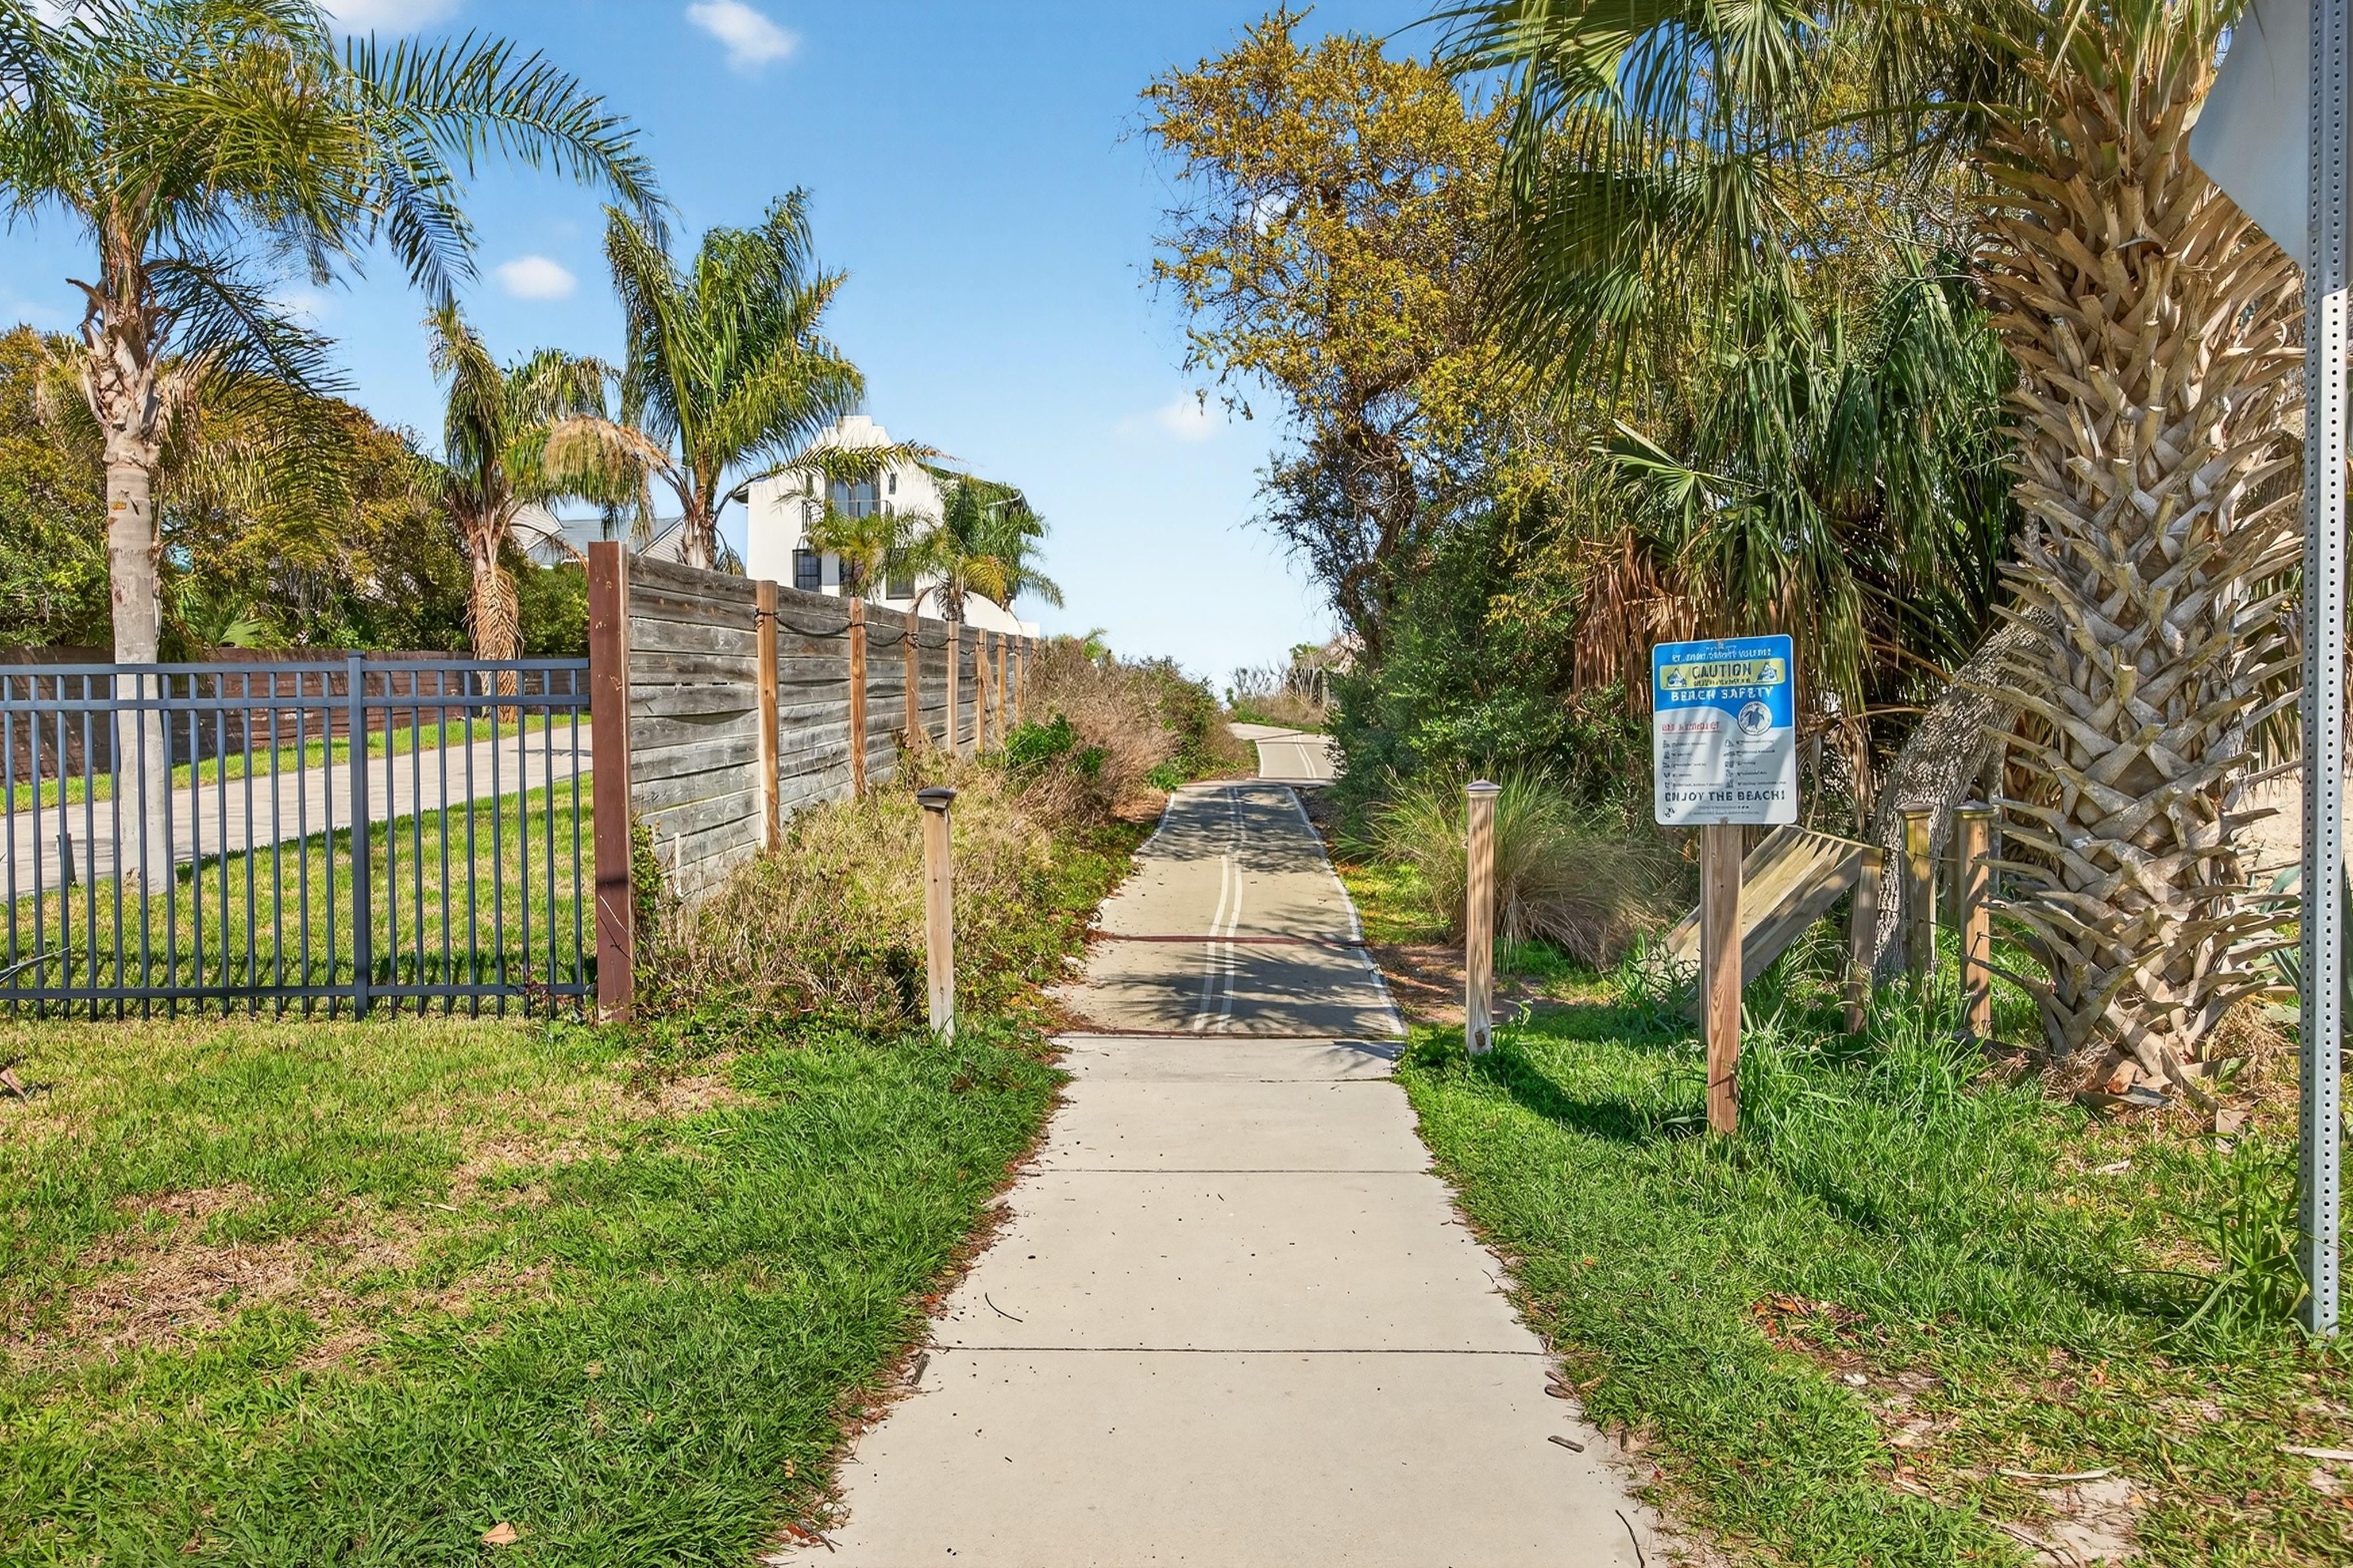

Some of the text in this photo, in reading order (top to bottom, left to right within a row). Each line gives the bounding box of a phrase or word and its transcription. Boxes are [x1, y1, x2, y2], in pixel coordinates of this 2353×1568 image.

[1692, 663, 1752, 679] CAUTION
[1671, 686, 1774, 702] BEACH SAFETY
[1665, 790, 1785, 802] ENJOY THE BEACH!
